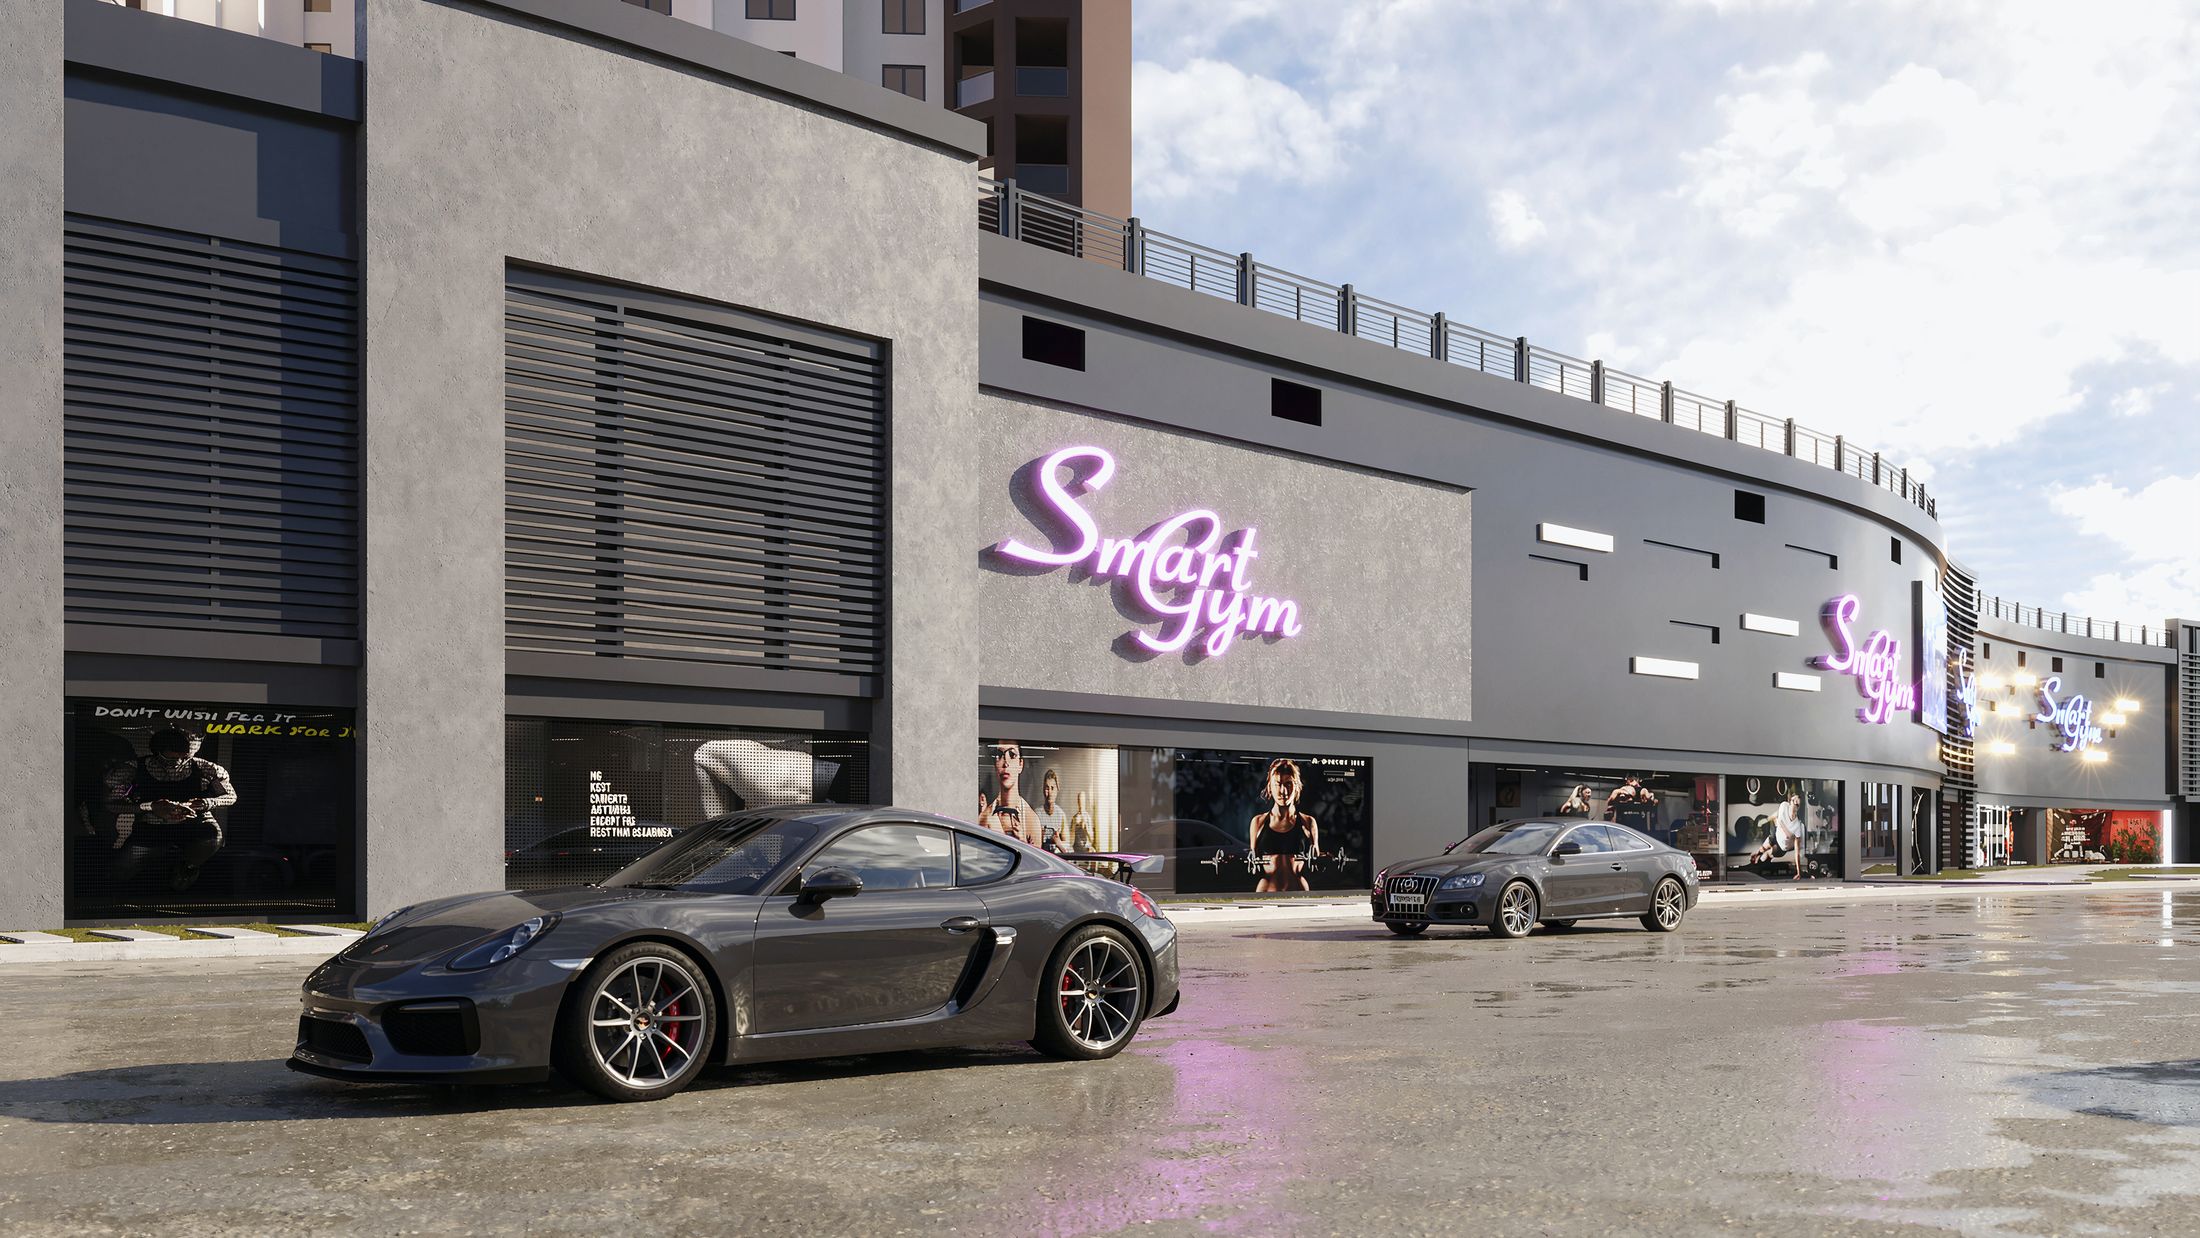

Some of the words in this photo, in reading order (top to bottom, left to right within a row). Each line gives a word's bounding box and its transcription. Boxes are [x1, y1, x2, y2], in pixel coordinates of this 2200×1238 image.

[1000, 446, 1258, 592] Smart
[1826, 594, 1901, 681] Smart
[95, 706, 160, 718] DON'T
[2036, 677, 2092, 726] Smart
